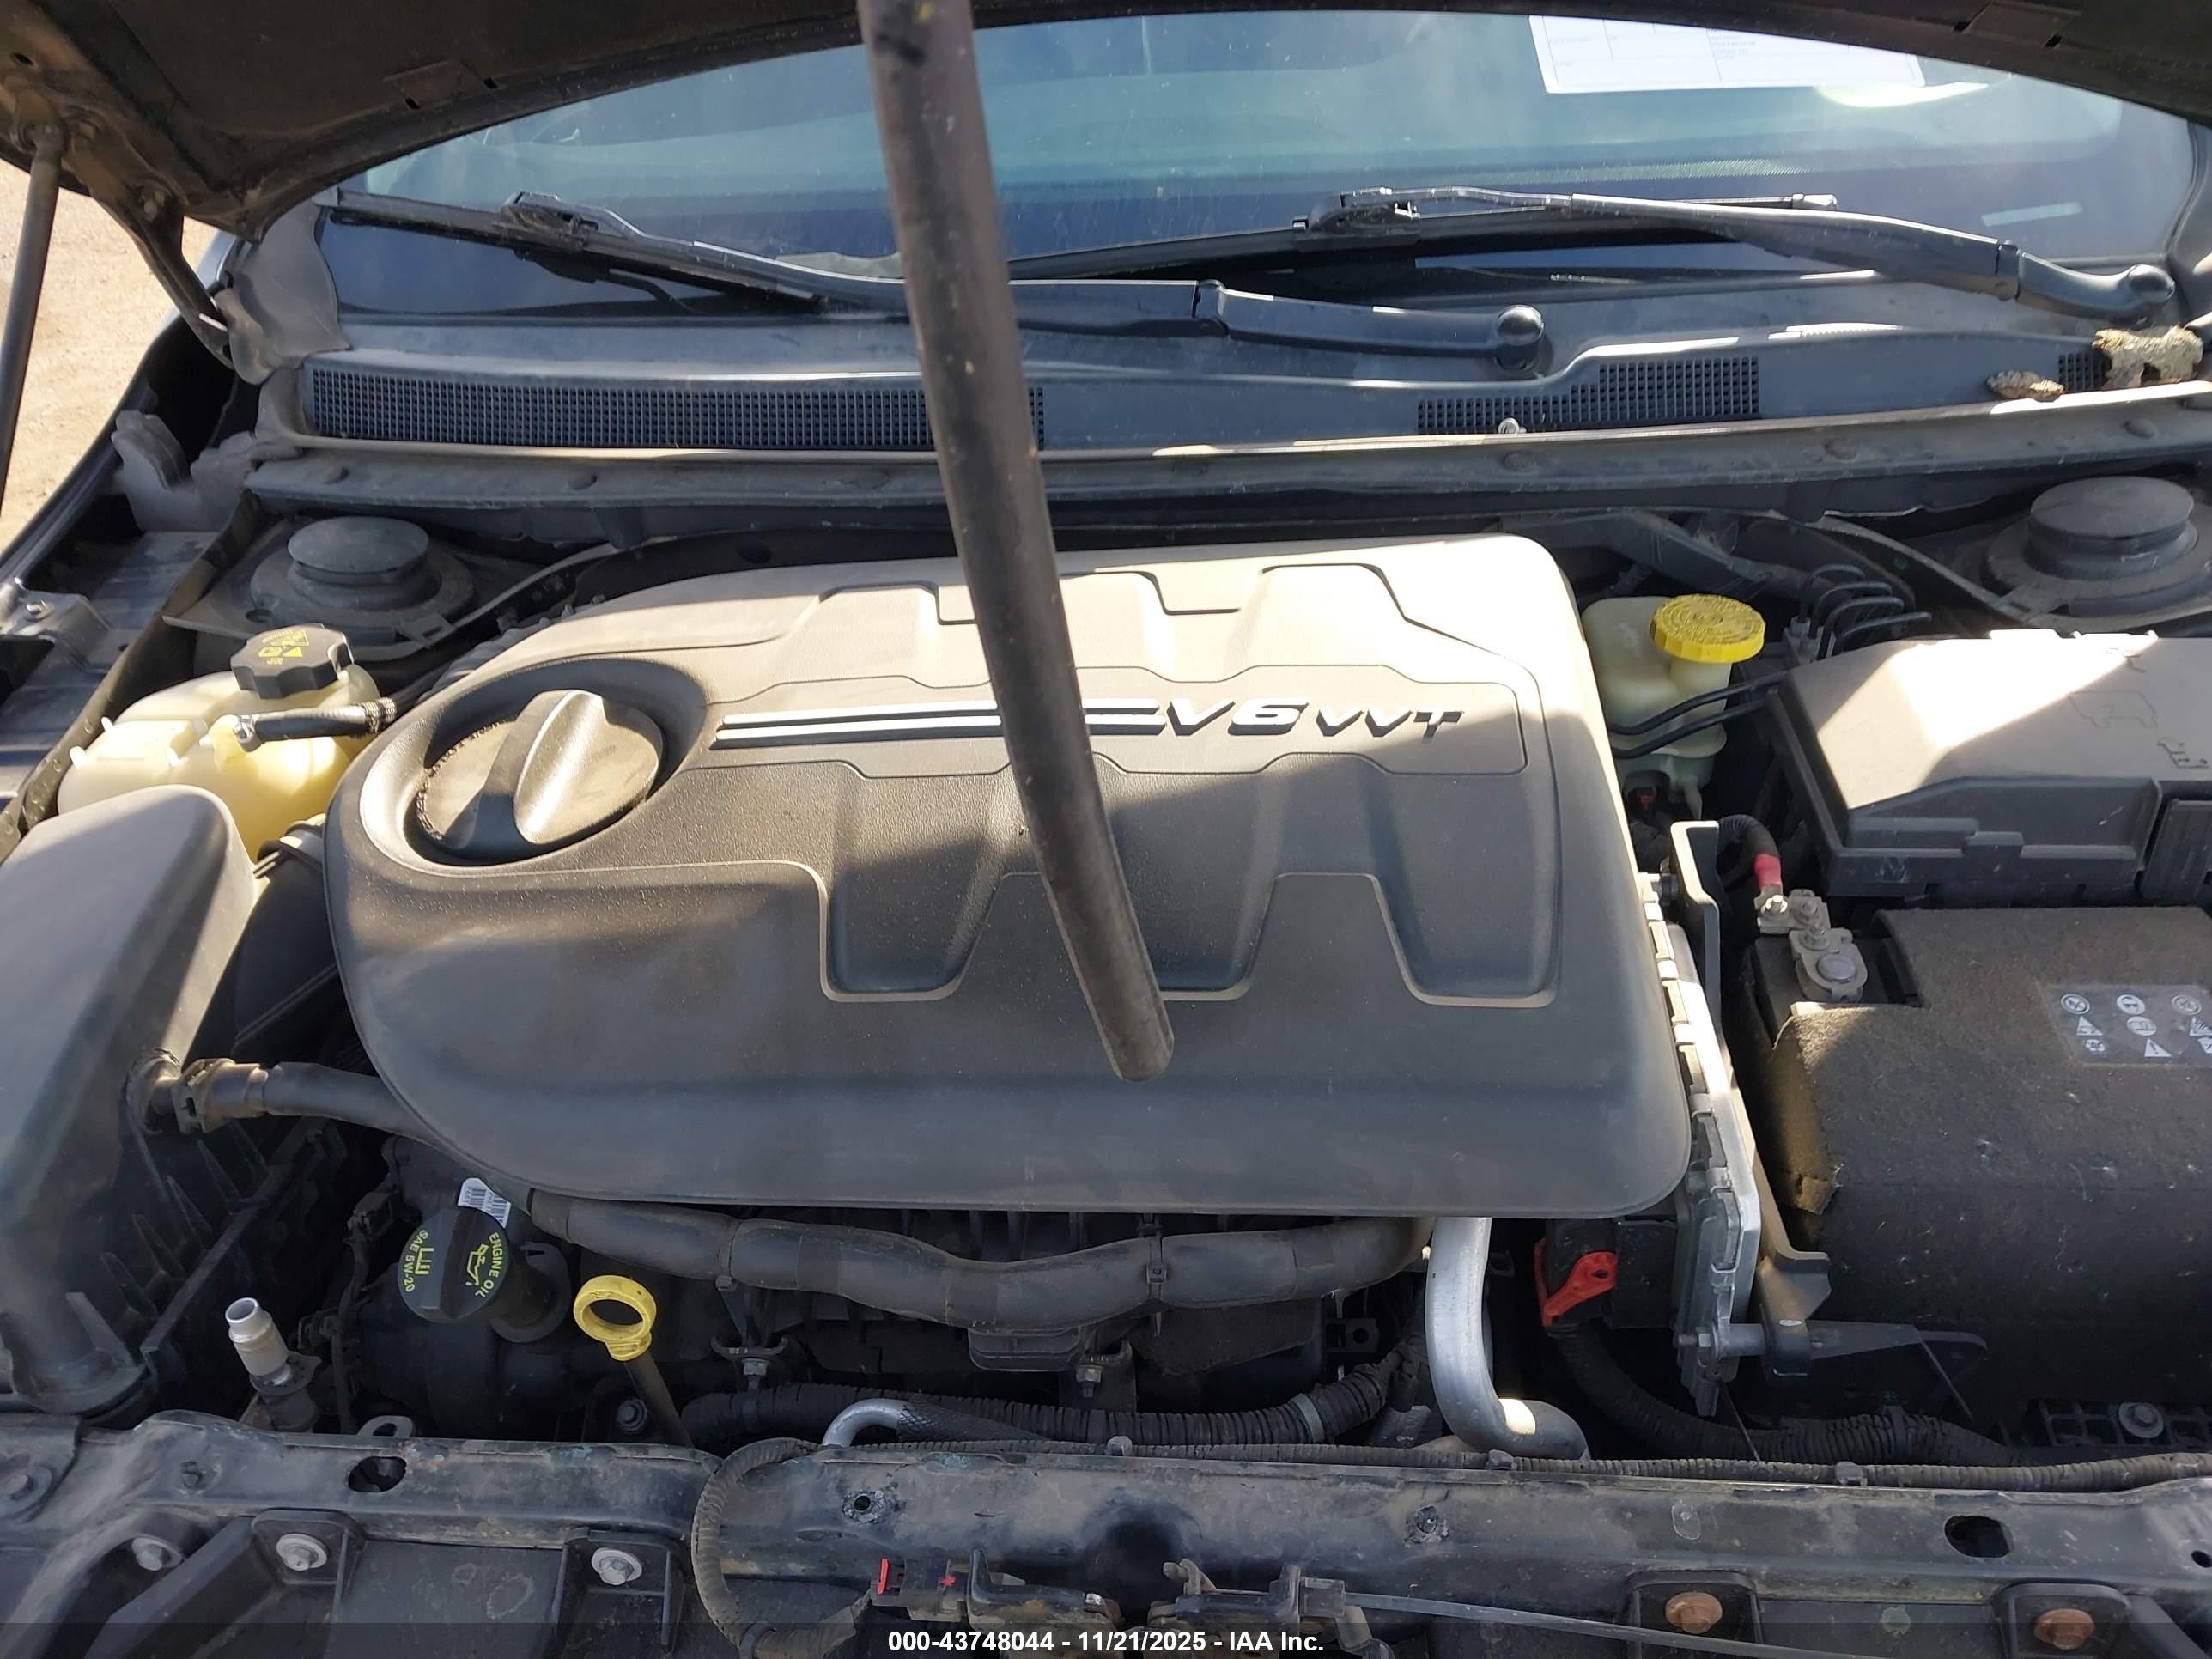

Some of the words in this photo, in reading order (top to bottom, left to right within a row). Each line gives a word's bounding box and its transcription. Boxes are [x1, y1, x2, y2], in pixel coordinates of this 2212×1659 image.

[410, 1230, 429, 1253] SAE
[489, 1231, 503, 1279] ENGINE
[403, 1255, 416, 1292] 5W-20
[474, 1279, 495, 1298] OIL
